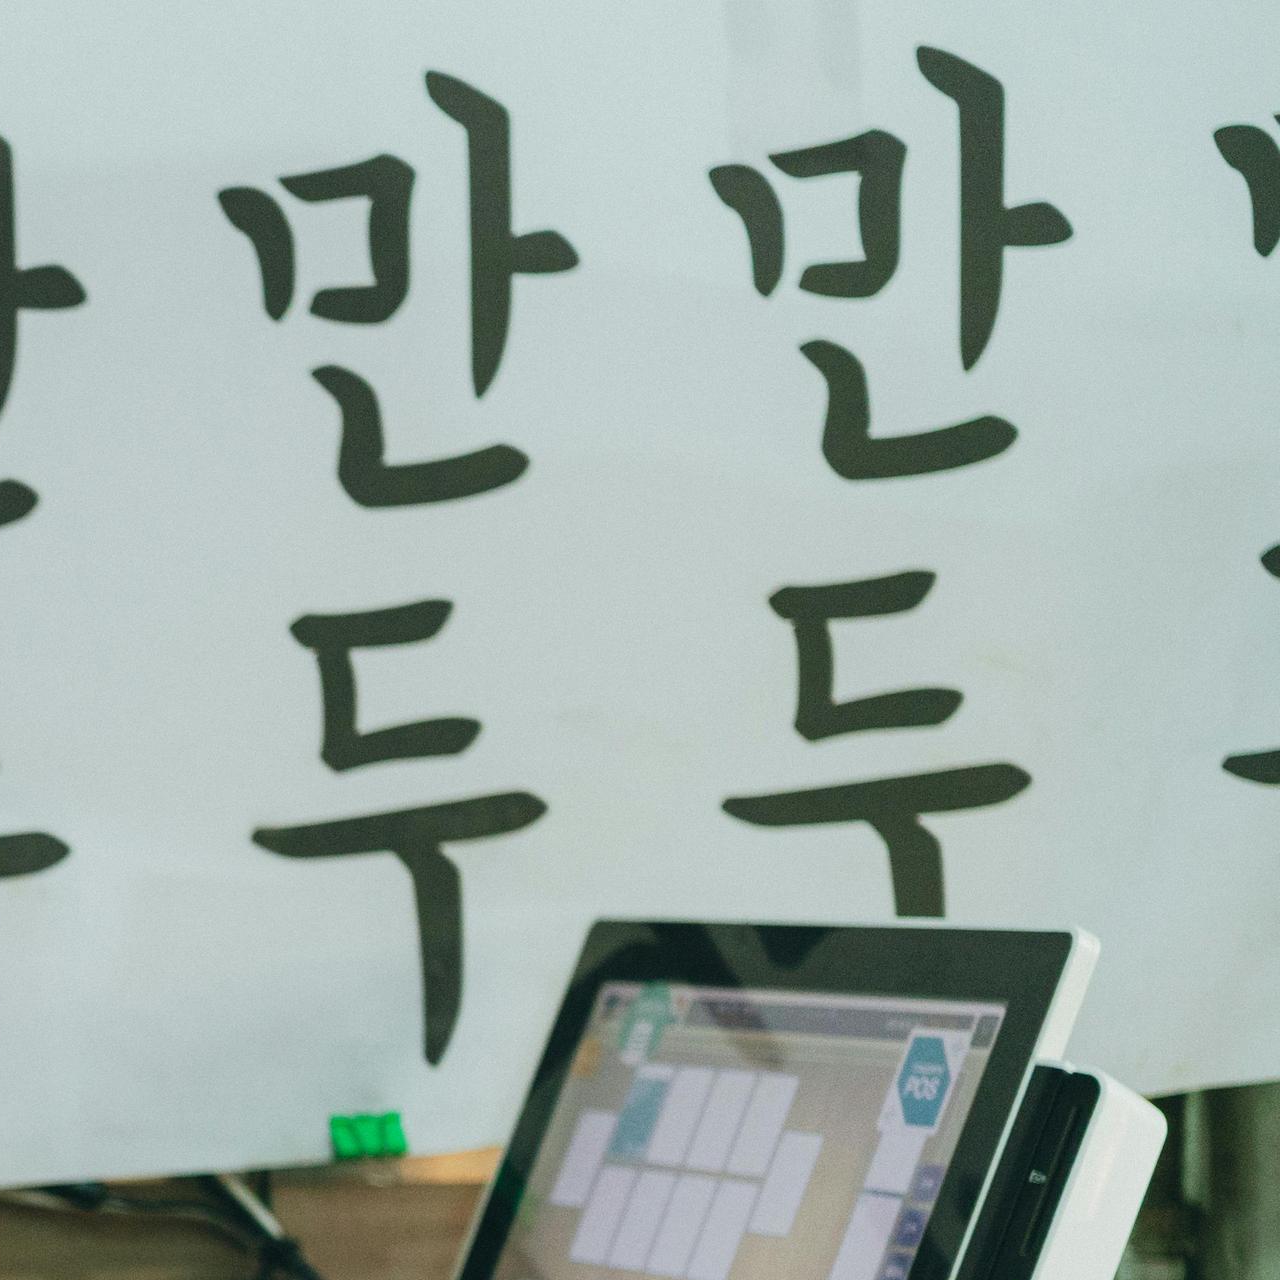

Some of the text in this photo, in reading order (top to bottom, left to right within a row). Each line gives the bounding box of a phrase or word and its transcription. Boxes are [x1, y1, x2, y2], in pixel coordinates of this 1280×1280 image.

[216, 70, 580, 1067] 만두
[708, 45, 1074, 919] 만두
[903, 1075, 941, 1101] POS
